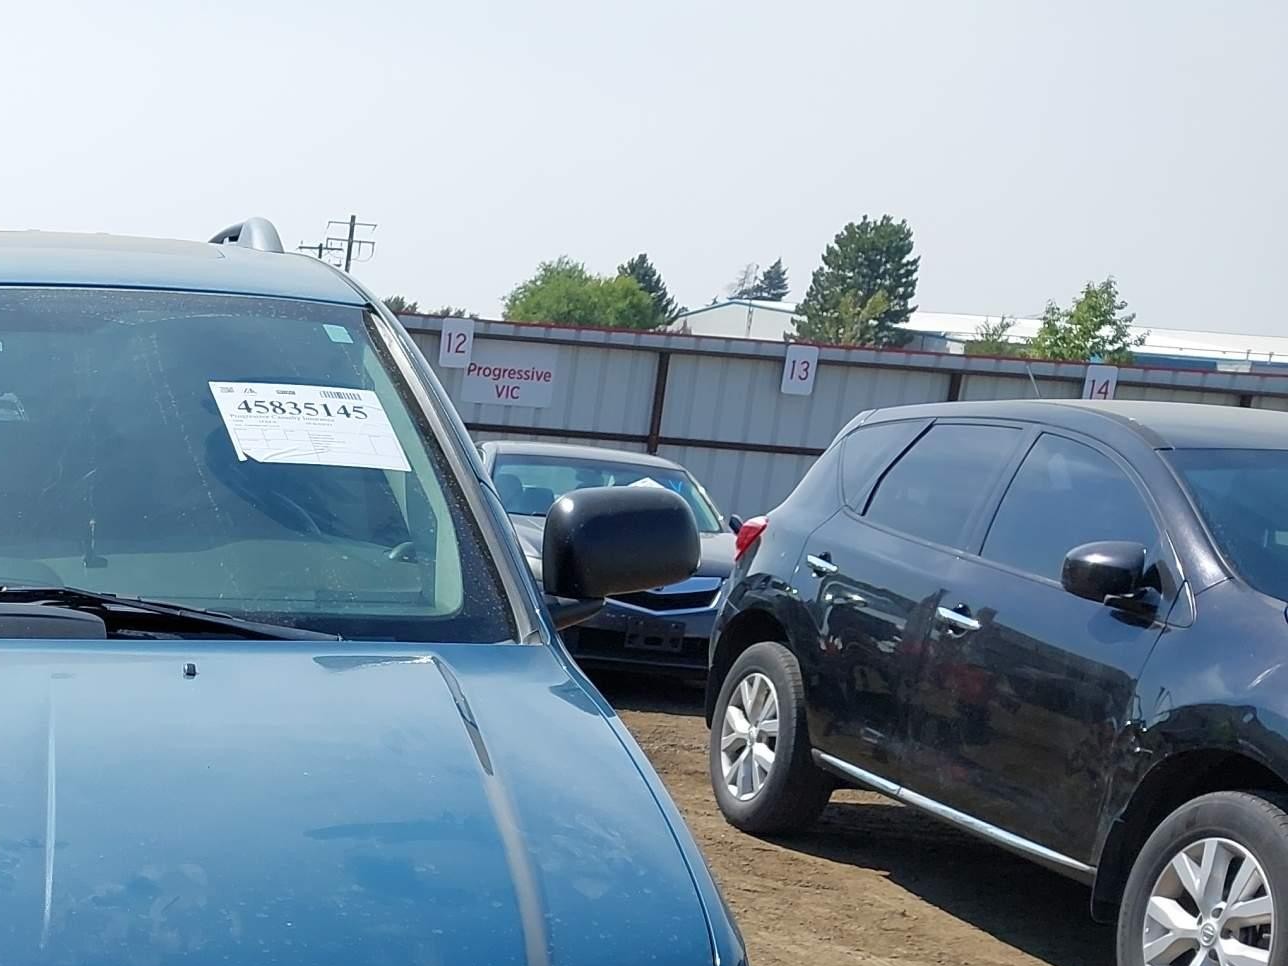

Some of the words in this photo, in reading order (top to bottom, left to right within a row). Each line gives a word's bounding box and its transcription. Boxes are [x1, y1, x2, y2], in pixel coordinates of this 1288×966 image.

[447, 332, 466, 353] 12
[467, 362, 551, 382] Progressive
[790, 360, 810, 381] 13
[495, 385, 520, 399] VIC
[1089, 379, 1110, 400] 14
[237, 399, 368, 420] 45835145
